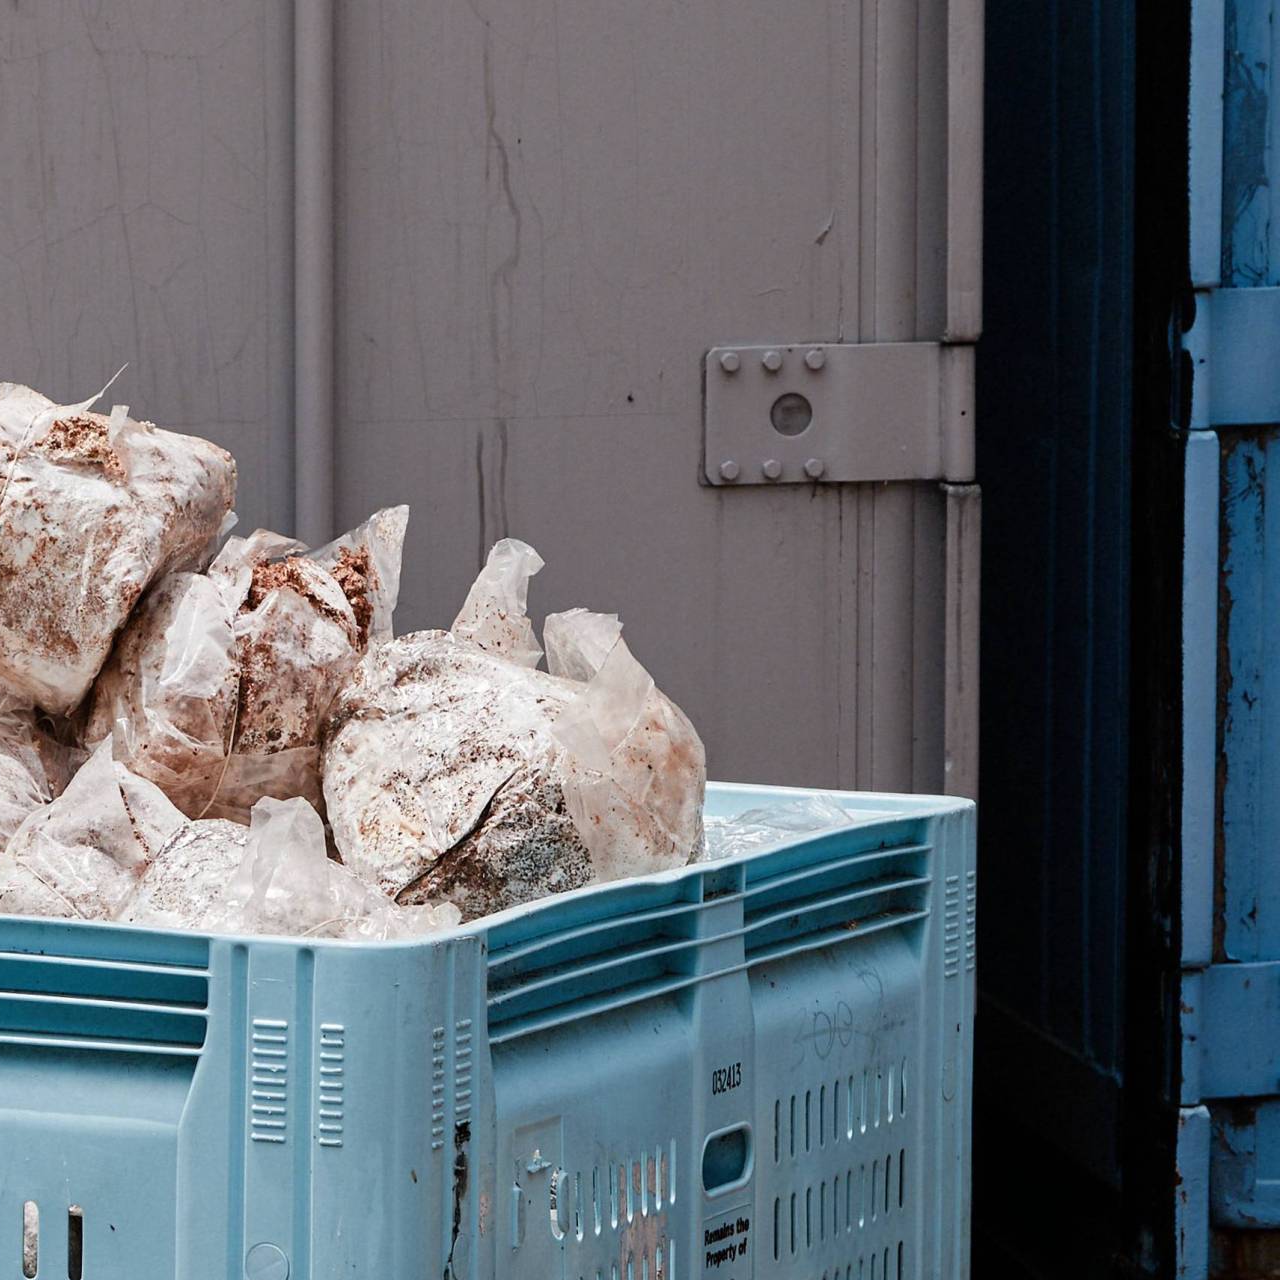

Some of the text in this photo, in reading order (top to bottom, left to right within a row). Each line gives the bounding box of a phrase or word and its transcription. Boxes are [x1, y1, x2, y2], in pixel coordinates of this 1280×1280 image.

[712, 1062, 741, 1096] 032413
[704, 1217, 750, 1247] Remains the
[706, 1237, 747, 1269] Property of
